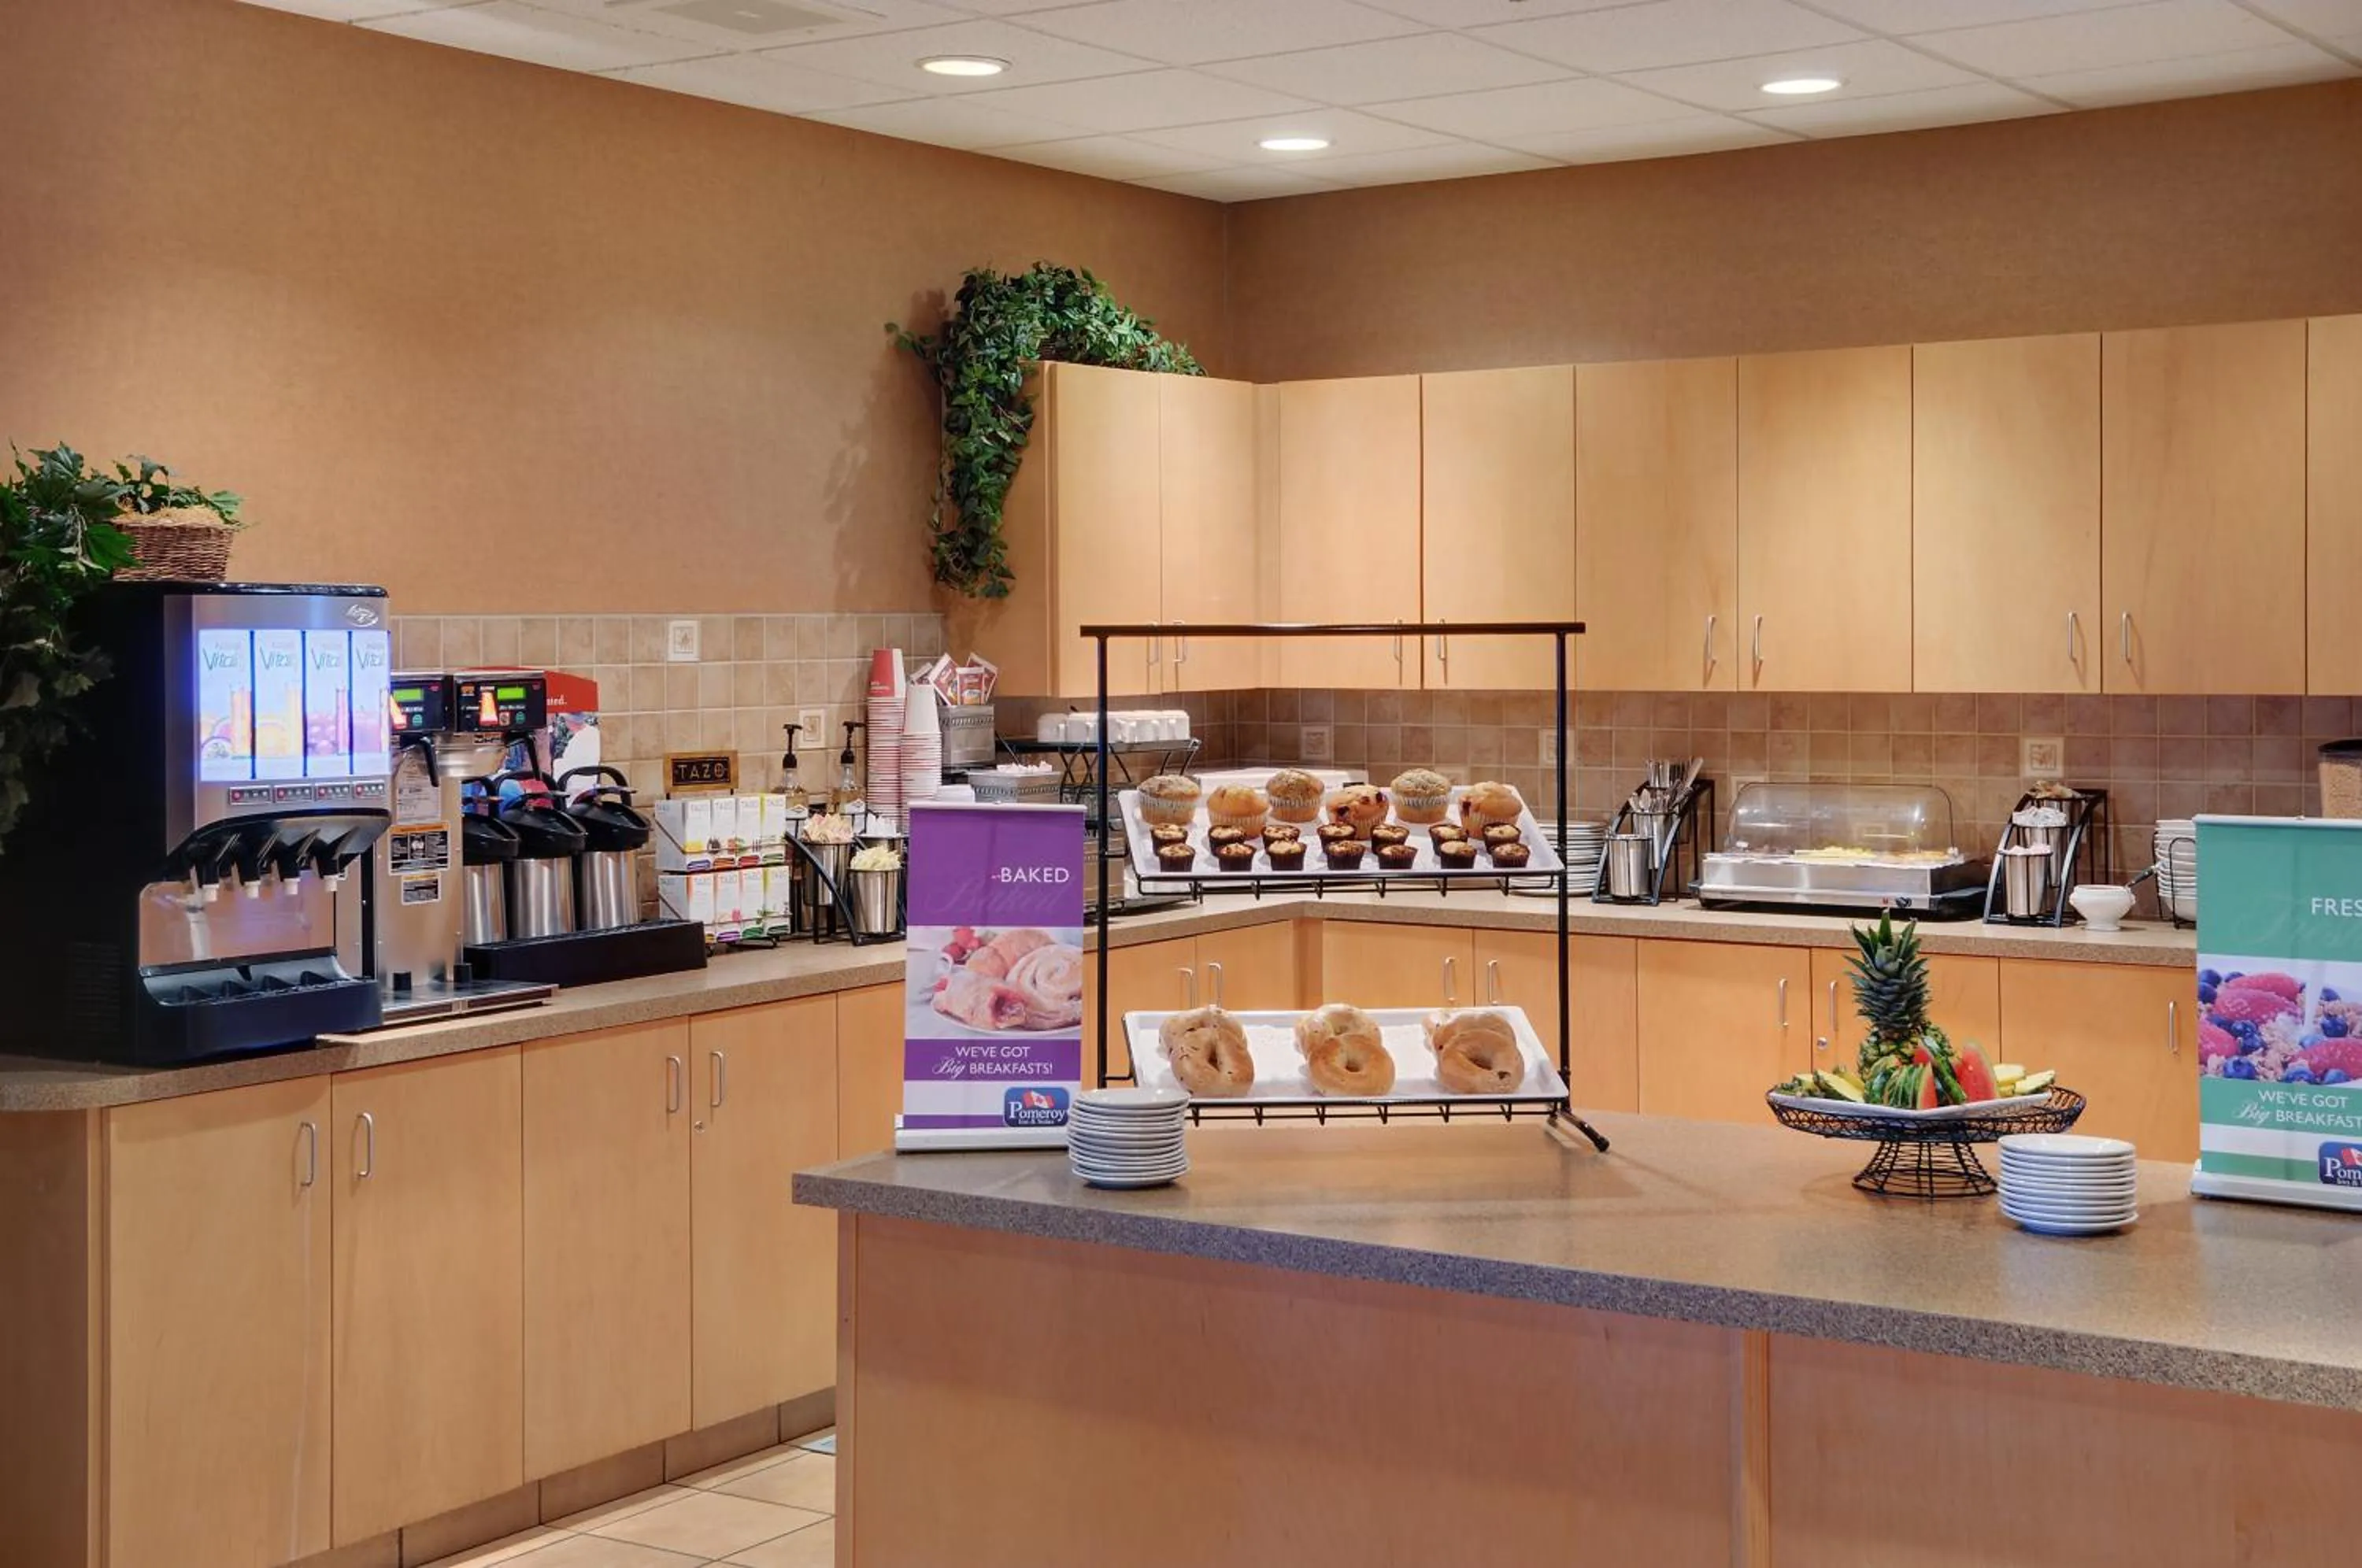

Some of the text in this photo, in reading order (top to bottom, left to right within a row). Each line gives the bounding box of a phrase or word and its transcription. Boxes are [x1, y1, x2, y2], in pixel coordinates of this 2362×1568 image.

[677, 762, 725, 780] TAZO
[1001, 867, 1070, 883] BAKED
[2311, 897, 2362, 918] FRES
[955, 1046, 1031, 1058] WE'VE GOT
[931, 1056, 1053, 1079] Big BREAKFASTS!
[2258, 1089, 2348, 1109] WE'VE GOT
[1008, 1101, 1066, 1122] Pomeroy
[2231, 1100, 2271, 1125] Big
[2323, 1156, 2362, 1179] Pom
